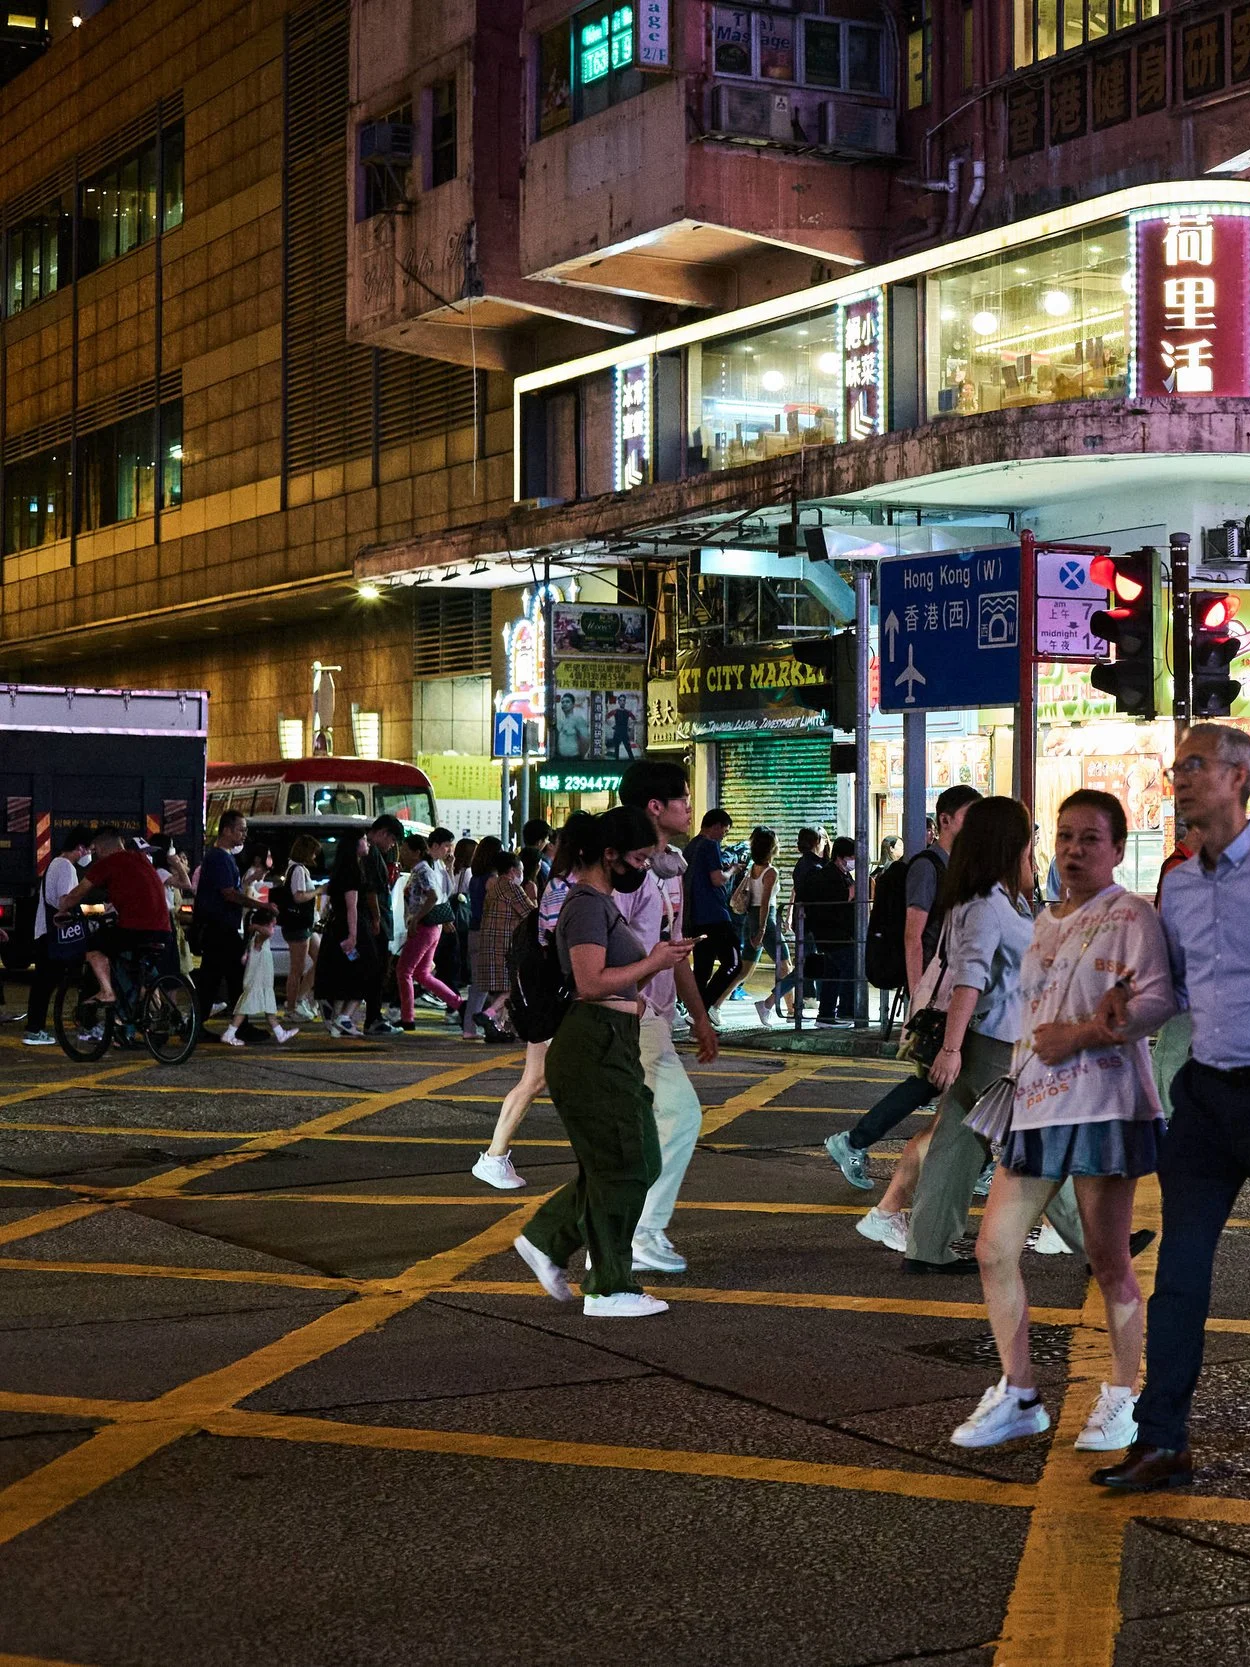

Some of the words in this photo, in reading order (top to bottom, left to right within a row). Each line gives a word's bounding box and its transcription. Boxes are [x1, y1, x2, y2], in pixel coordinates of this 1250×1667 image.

[733, 12, 775, 32] Tai
[717, 26, 790, 51] Masage
[1161, 215, 1216, 394] 荷里活
[904, 570, 933, 591] Hong
[941, 564, 970, 588] Kong
[977, 558, 1002, 582] (W)
[904, 599, 970, 632] 香港(西)
[1049, 609, 1070, 620] 上午
[1082, 602, 1093, 620] 7
[1041, 630, 1077, 639] midnight
[1082, 633, 1104, 650] 12
[1049, 640, 1070, 651] 午夜
[678, 667, 701, 695] KT
[706, 664, 745, 693] CITY
[564, 776, 623, 791] 2394477
[61, 924, 81, 939] Lee
